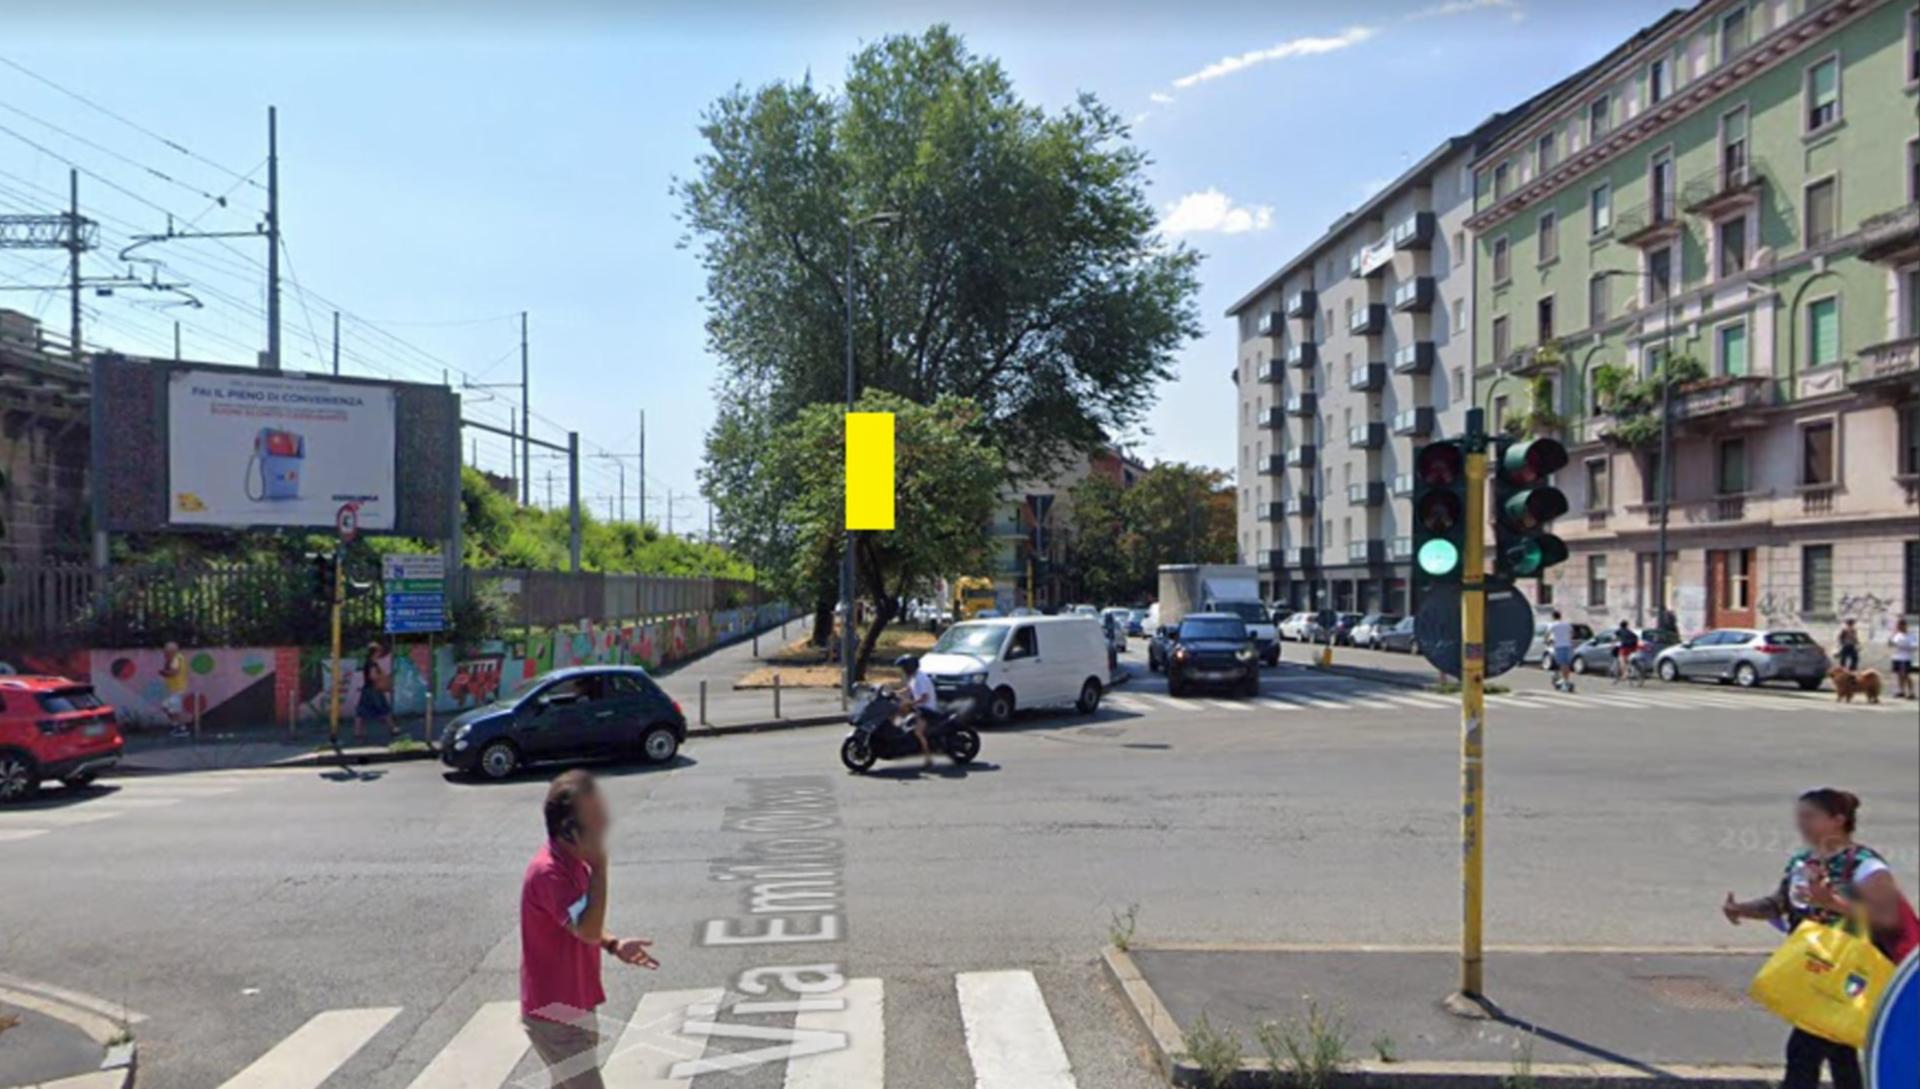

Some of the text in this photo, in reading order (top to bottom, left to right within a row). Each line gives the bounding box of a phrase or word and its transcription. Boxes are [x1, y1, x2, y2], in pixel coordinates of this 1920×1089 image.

[192, 386, 212, 397] FAI
[214, 388, 224, 399] IL
[227, 389, 265, 401] PIENO
[267, 391, 279, 401] DI
